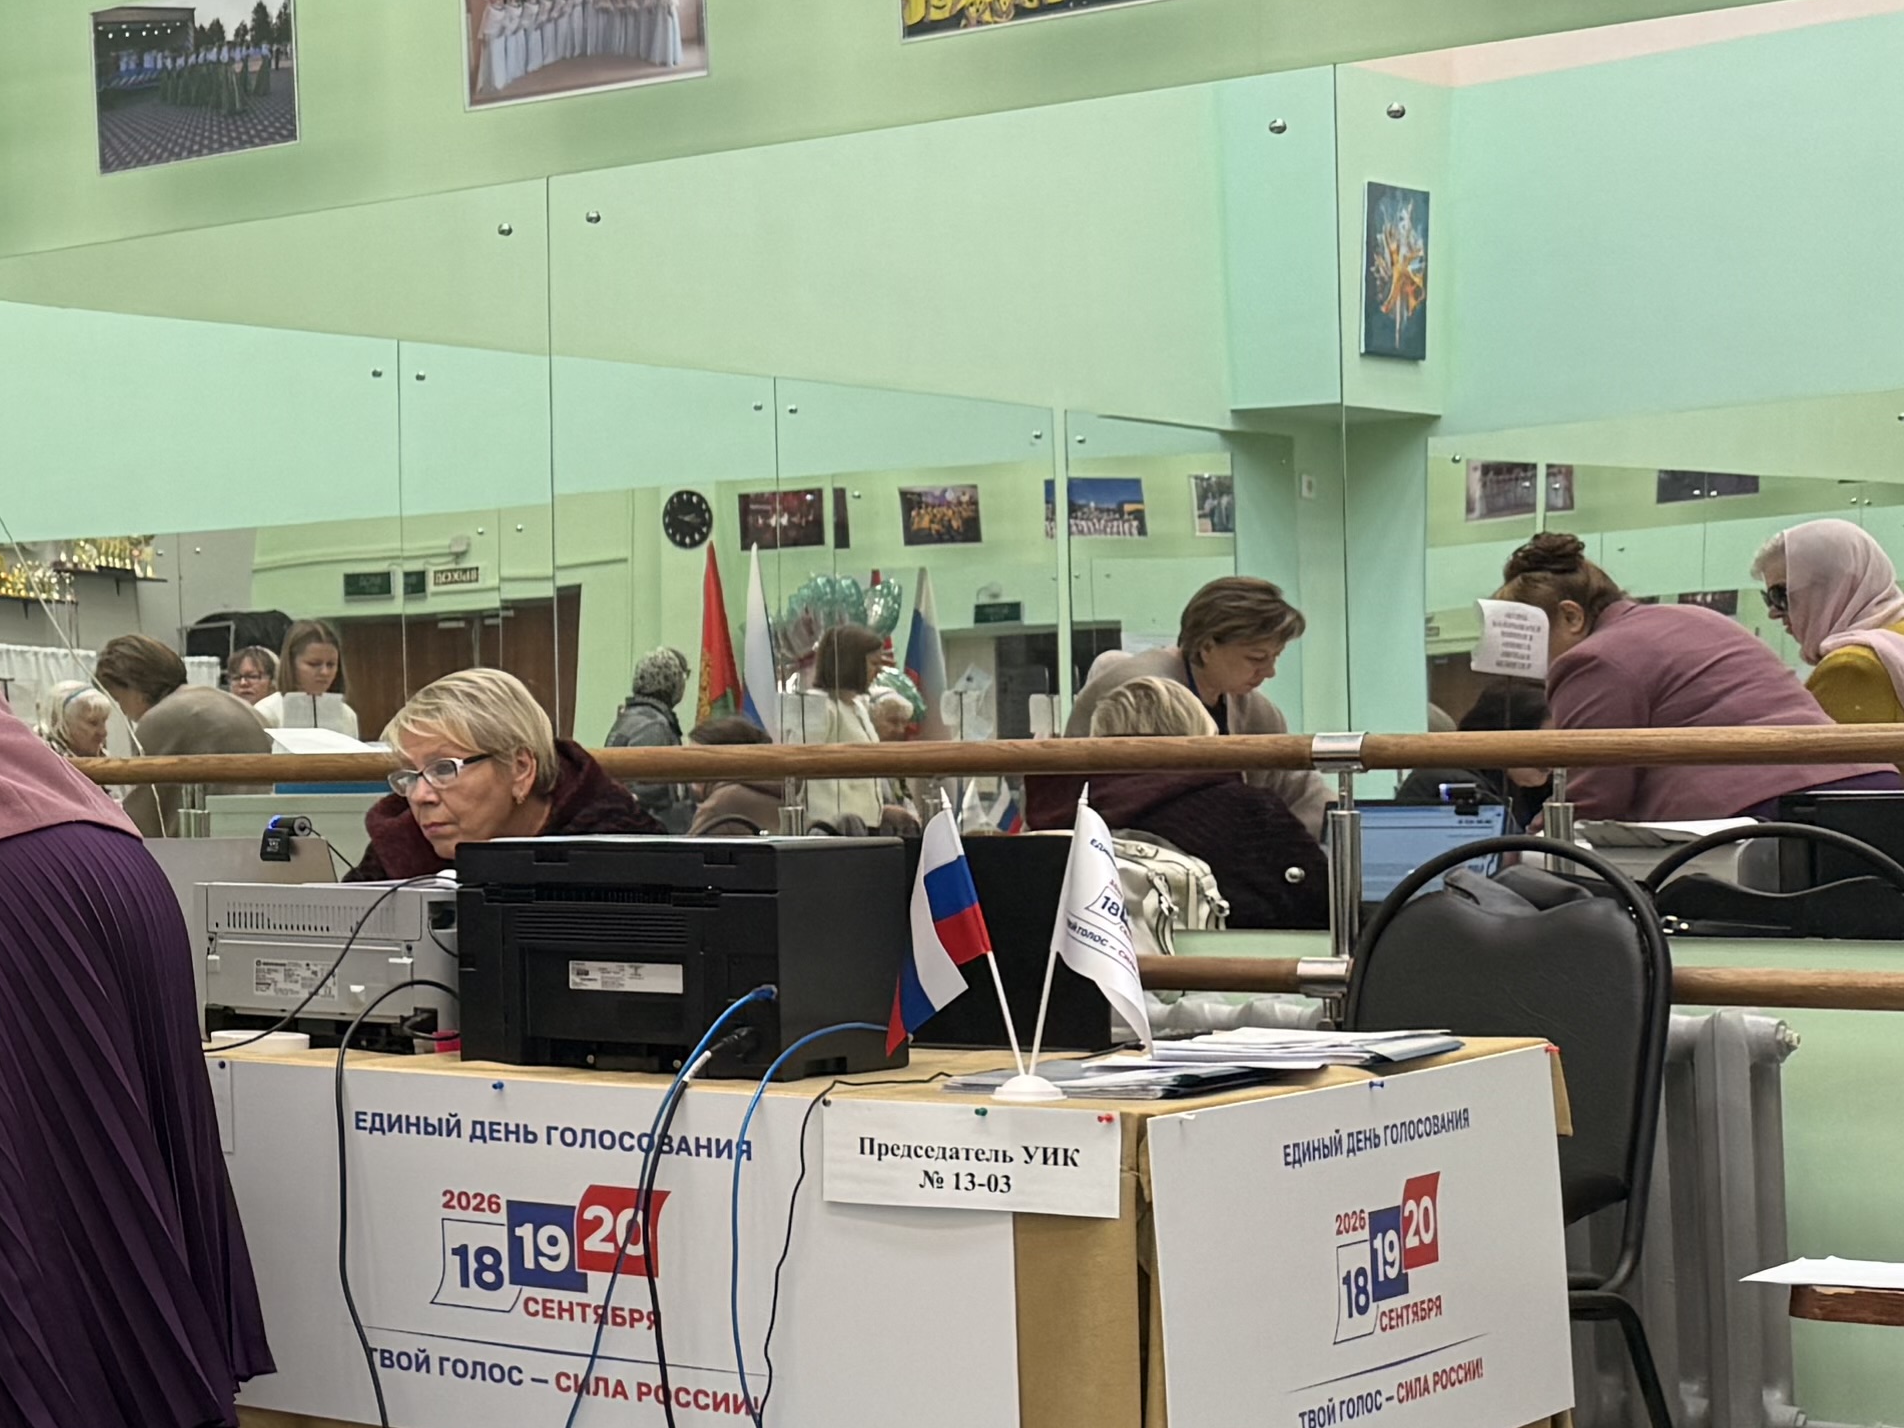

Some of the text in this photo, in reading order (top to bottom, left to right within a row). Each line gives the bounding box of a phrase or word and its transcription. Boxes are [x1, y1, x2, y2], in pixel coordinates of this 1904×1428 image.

[354, 1111, 753, 1161] ЕДИНЫЙ ДЕНЬ ГОЛОСОВАНИЯ
[858, 1136, 1081, 1167] Председатель УИК
[1283, 1107, 1471, 1169] ЕДИНЫЙ ДЕНЬ ГОЛОСОВАНИЯ
[441, 1189, 502, 1214] 2026
[918, 1169, 1013, 1194] № 13-03
[514, 1222, 571, 1272] 19
[583, 1205, 650, 1257] 20
[1335, 1208, 1367, 1236] 2026
[1403, 1195, 1435, 1249] 20
[450, 1243, 505, 1292] 18
[1373, 1229, 1401, 1282] 19
[1342, 1266, 1371, 1319] 18
[1379, 1294, 1443, 1333] СЕНТЯБРЯ
[438, 1357, 524, 1386] ГОЛОС
[554, 1371, 629, 1401] СИЛА
[1339, 1389, 1383, 1422] ГОЛОС
[1396, 1373, 1431, 1404] СИЛА
[1432, 1356, 1484, 1393] РОССИИ!
